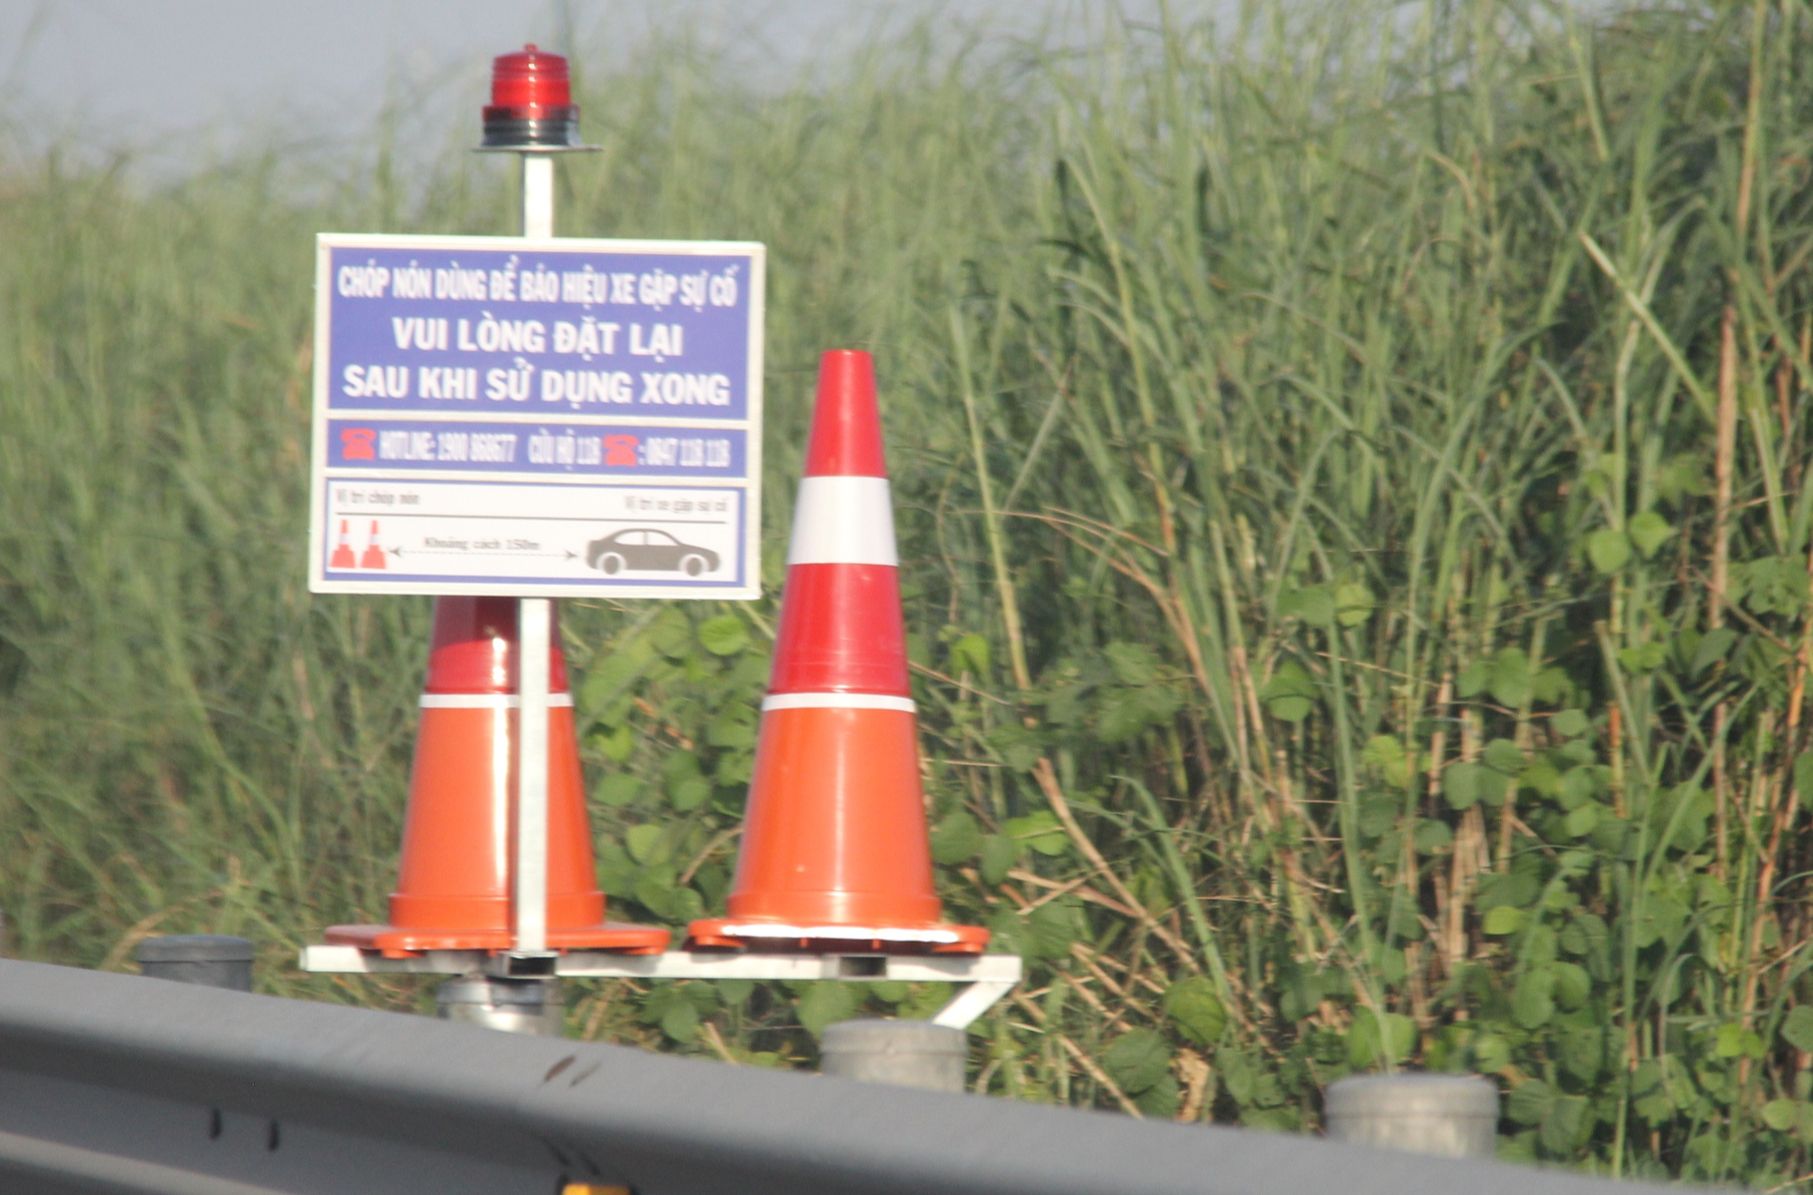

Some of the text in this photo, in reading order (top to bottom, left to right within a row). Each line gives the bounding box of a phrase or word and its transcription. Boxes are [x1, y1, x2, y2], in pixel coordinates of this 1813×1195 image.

[339, 258, 390, 297] CHÓP
[393, 259, 432, 299] NÓN
[435, 261, 487, 300] DÙNG
[490, 255, 519, 301] ĐỂ
[521, 263, 559, 303] BÁO
[562, 264, 608, 310] HIỆU
[610, 272, 636, 305] XE
[680, 270, 708, 312] SỰ
[709, 264, 739, 307] CỐ
[393, 312, 683, 362] VUI LÒNG ĐẶT LẠI
[343, 357, 731, 408] SAU KHI SỬ DỤNG XONG
